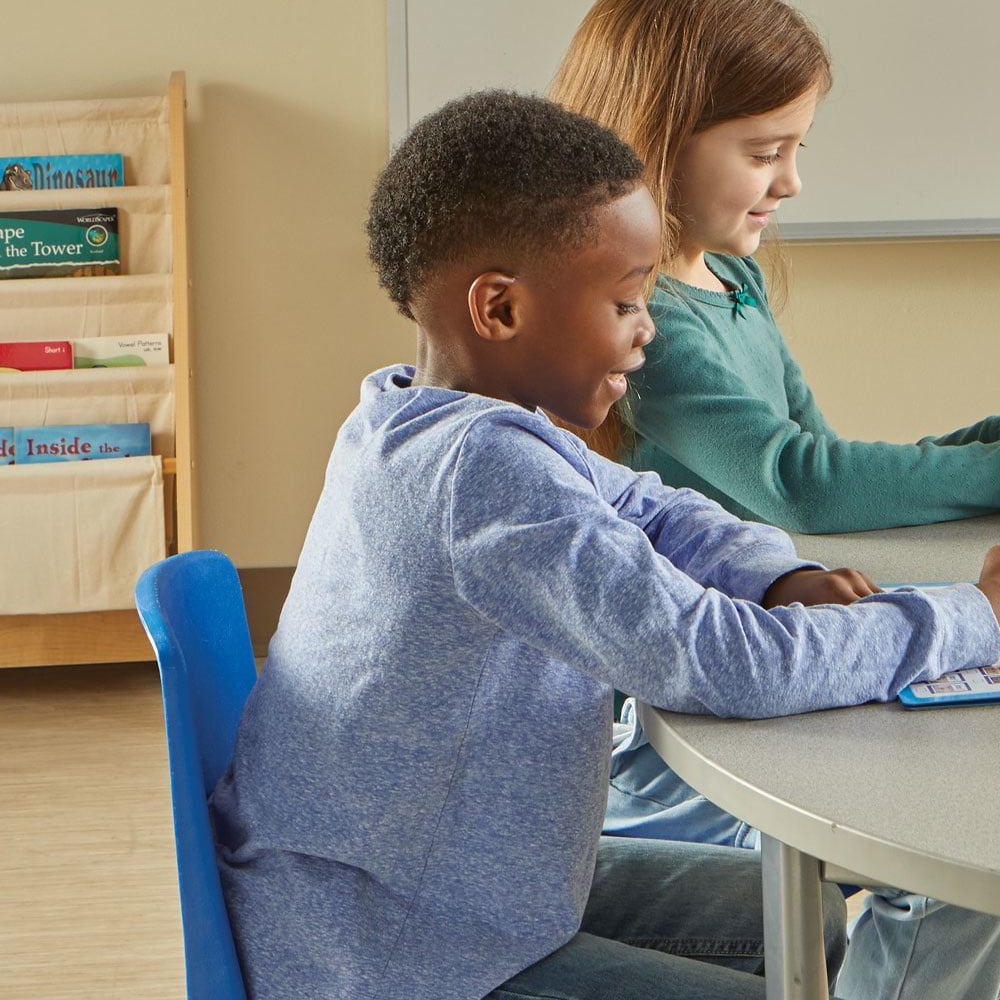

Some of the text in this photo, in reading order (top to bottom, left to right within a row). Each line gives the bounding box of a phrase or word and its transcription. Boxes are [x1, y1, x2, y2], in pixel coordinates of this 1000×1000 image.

[32, 162, 119, 190] Dinosaur
[6, 241, 84, 257] the Tower
[27, 436, 92, 456] Inside
[99, 443, 121, 453] the
